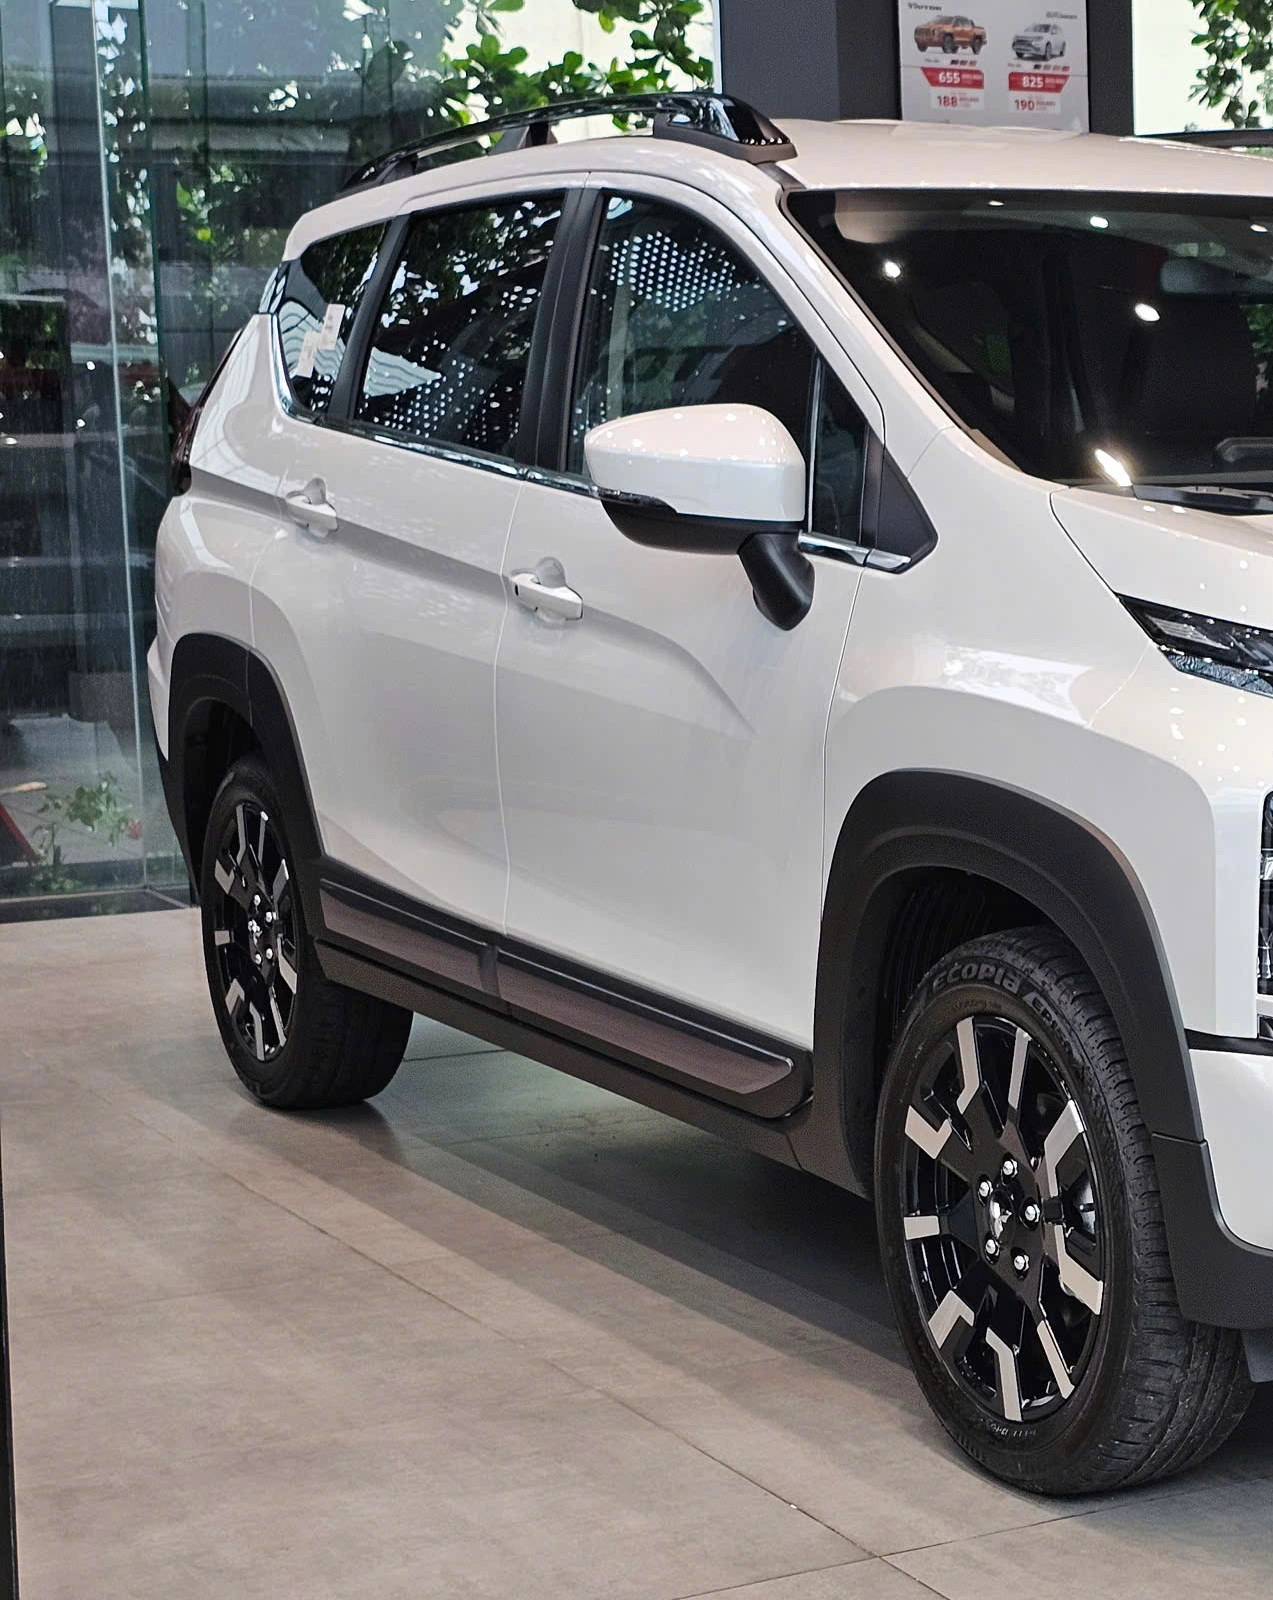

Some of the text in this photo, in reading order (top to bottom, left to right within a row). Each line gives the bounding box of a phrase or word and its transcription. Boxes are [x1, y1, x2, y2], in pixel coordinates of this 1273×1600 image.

[938, 71, 961, 84] 655
[1022, 75, 1044, 88] 825
[1015, 99, 1035, 111] 190
